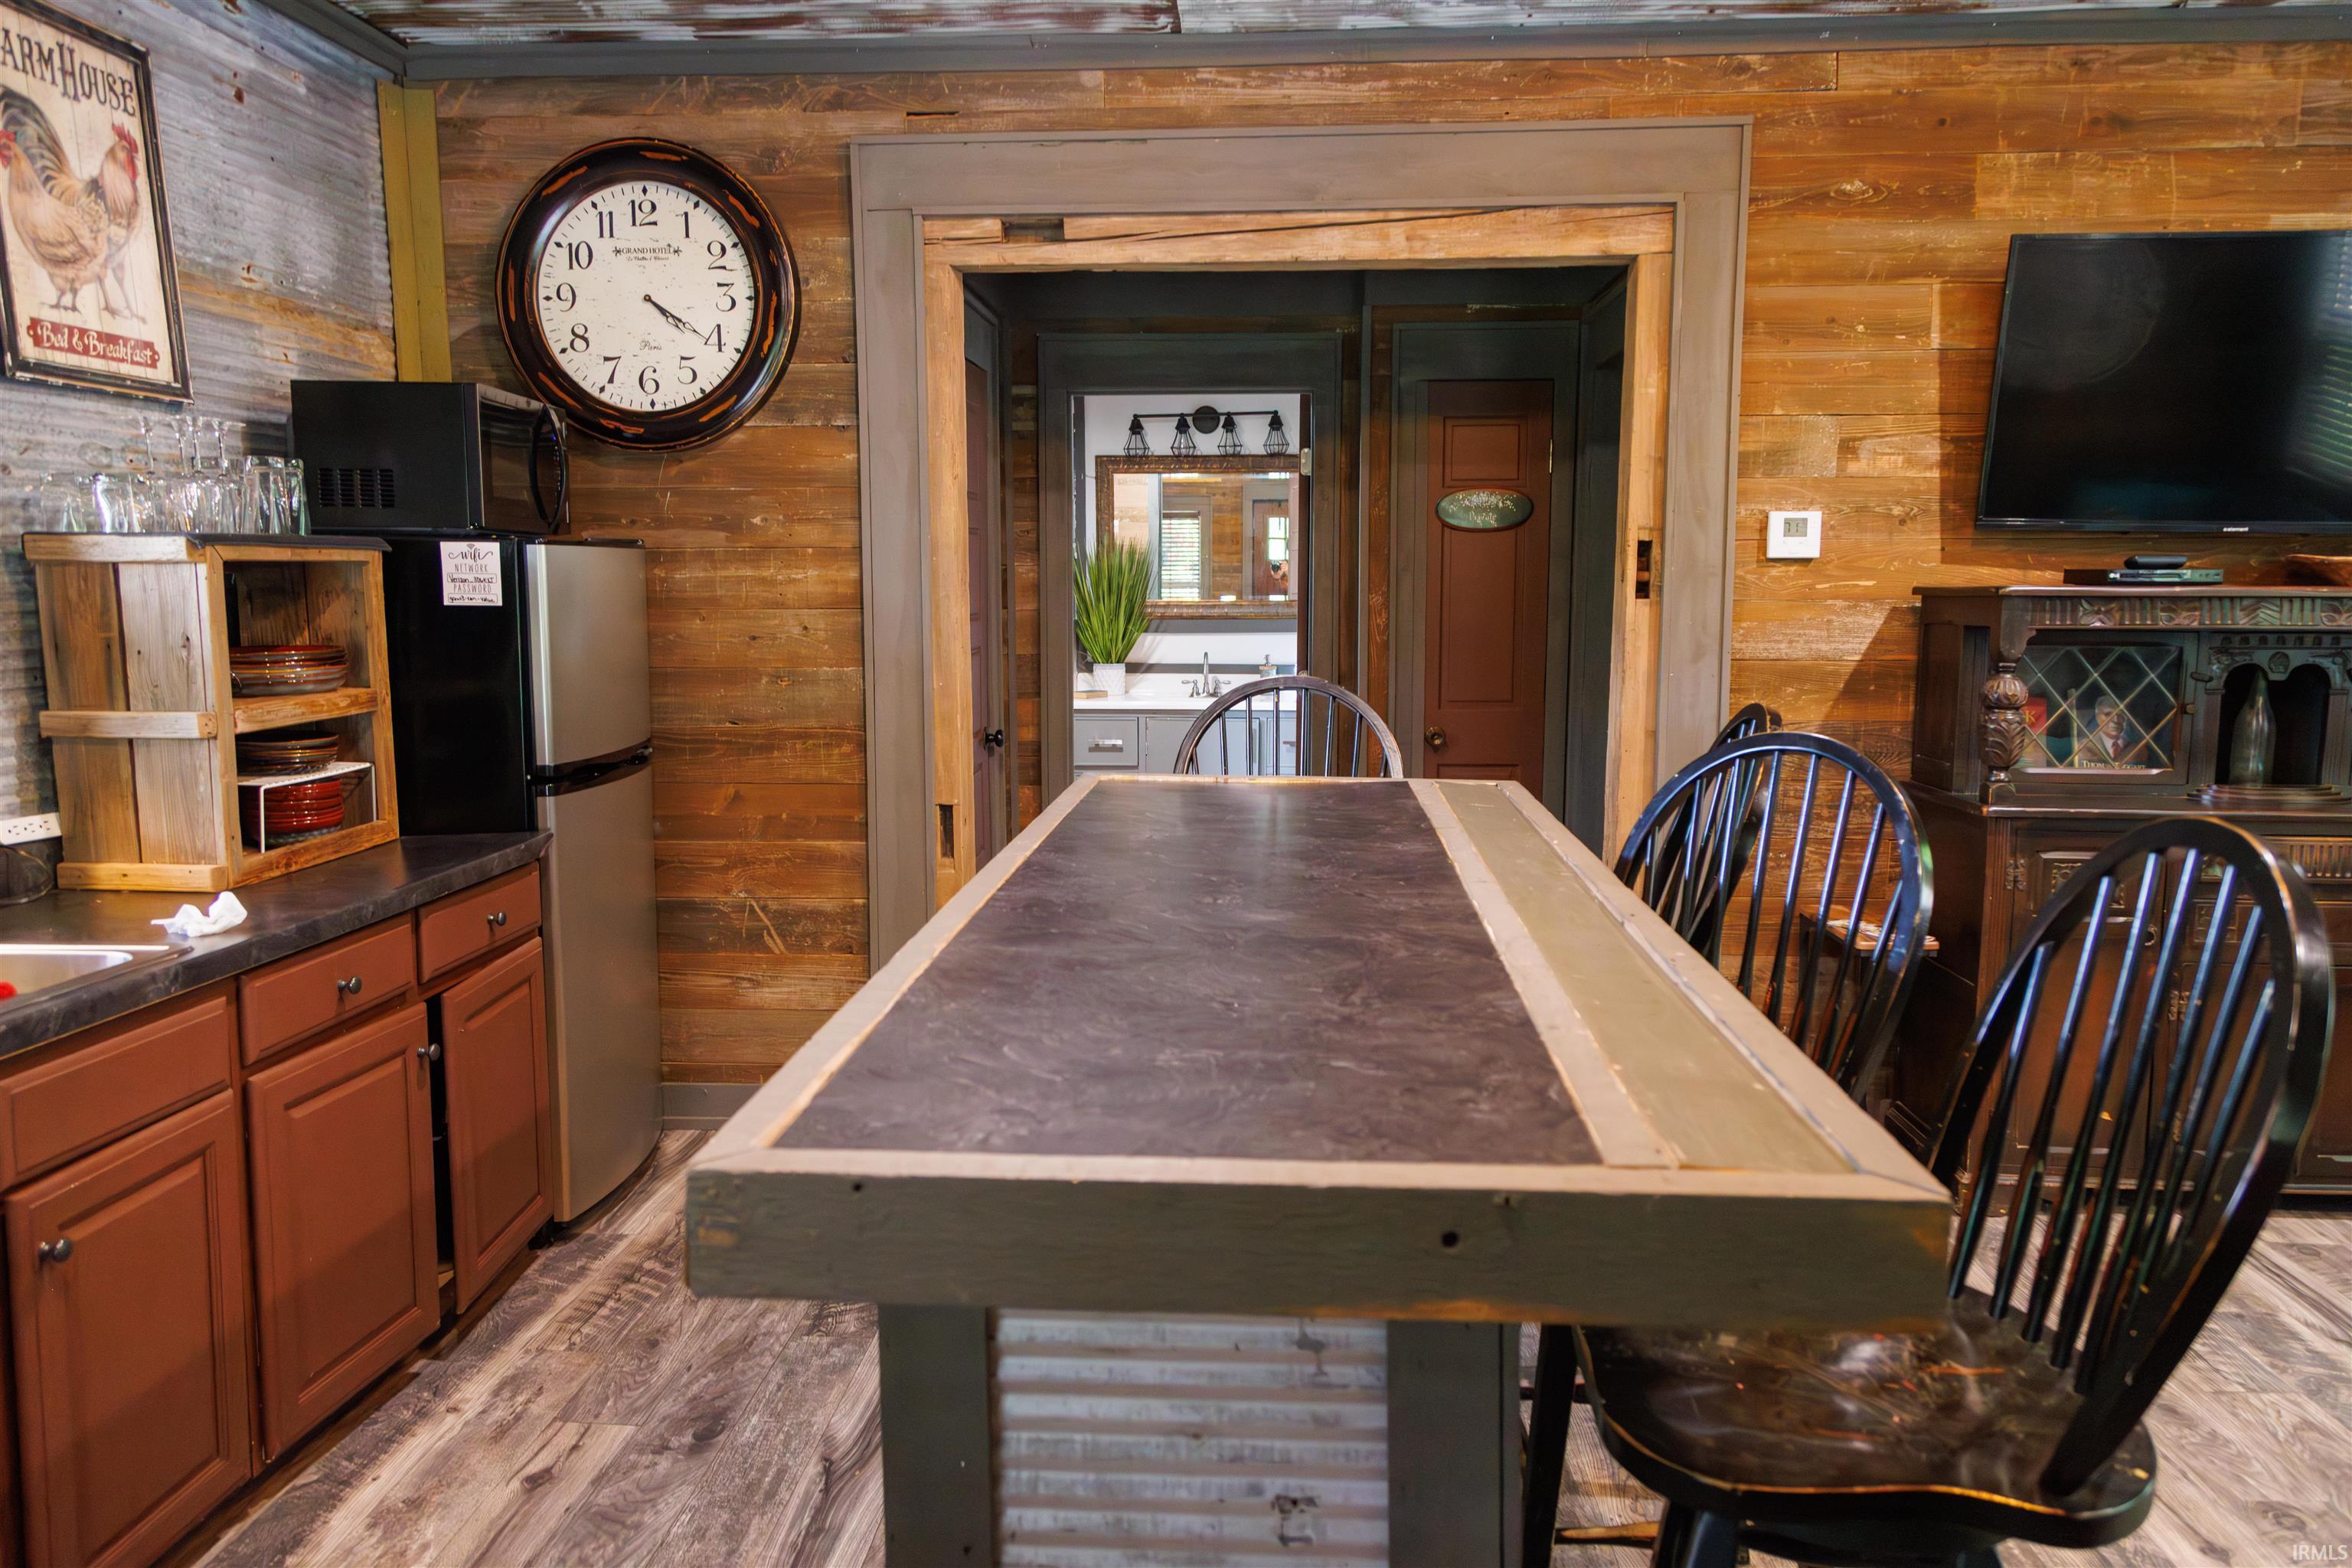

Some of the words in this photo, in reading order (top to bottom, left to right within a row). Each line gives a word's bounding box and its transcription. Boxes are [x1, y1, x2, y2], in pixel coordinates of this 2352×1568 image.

[1, 28, 136, 117] ARMHOUSE
[596, 211, 615, 238] 11
[628, 199, 658, 227] 12
[681, 211, 691, 239] 1
[565, 240, 593, 270] 10
[707, 240, 727, 270] 2
[556, 282, 577, 312] 9
[716, 282, 737, 312] 3
[38, 322, 68, 348] Bed
[72, 328, 83, 353] &
[84, 331, 152, 365] Breakfast
[570, 323, 590, 353] 8
[704, 323, 726, 353] 4
[603, 355, 622, 384] 7
[639, 365, 660, 395] 6
[678, 355, 697, 384] 5
[455, 564, 488, 573] NETWORK
[453, 583, 492, 593] PASSWORD
